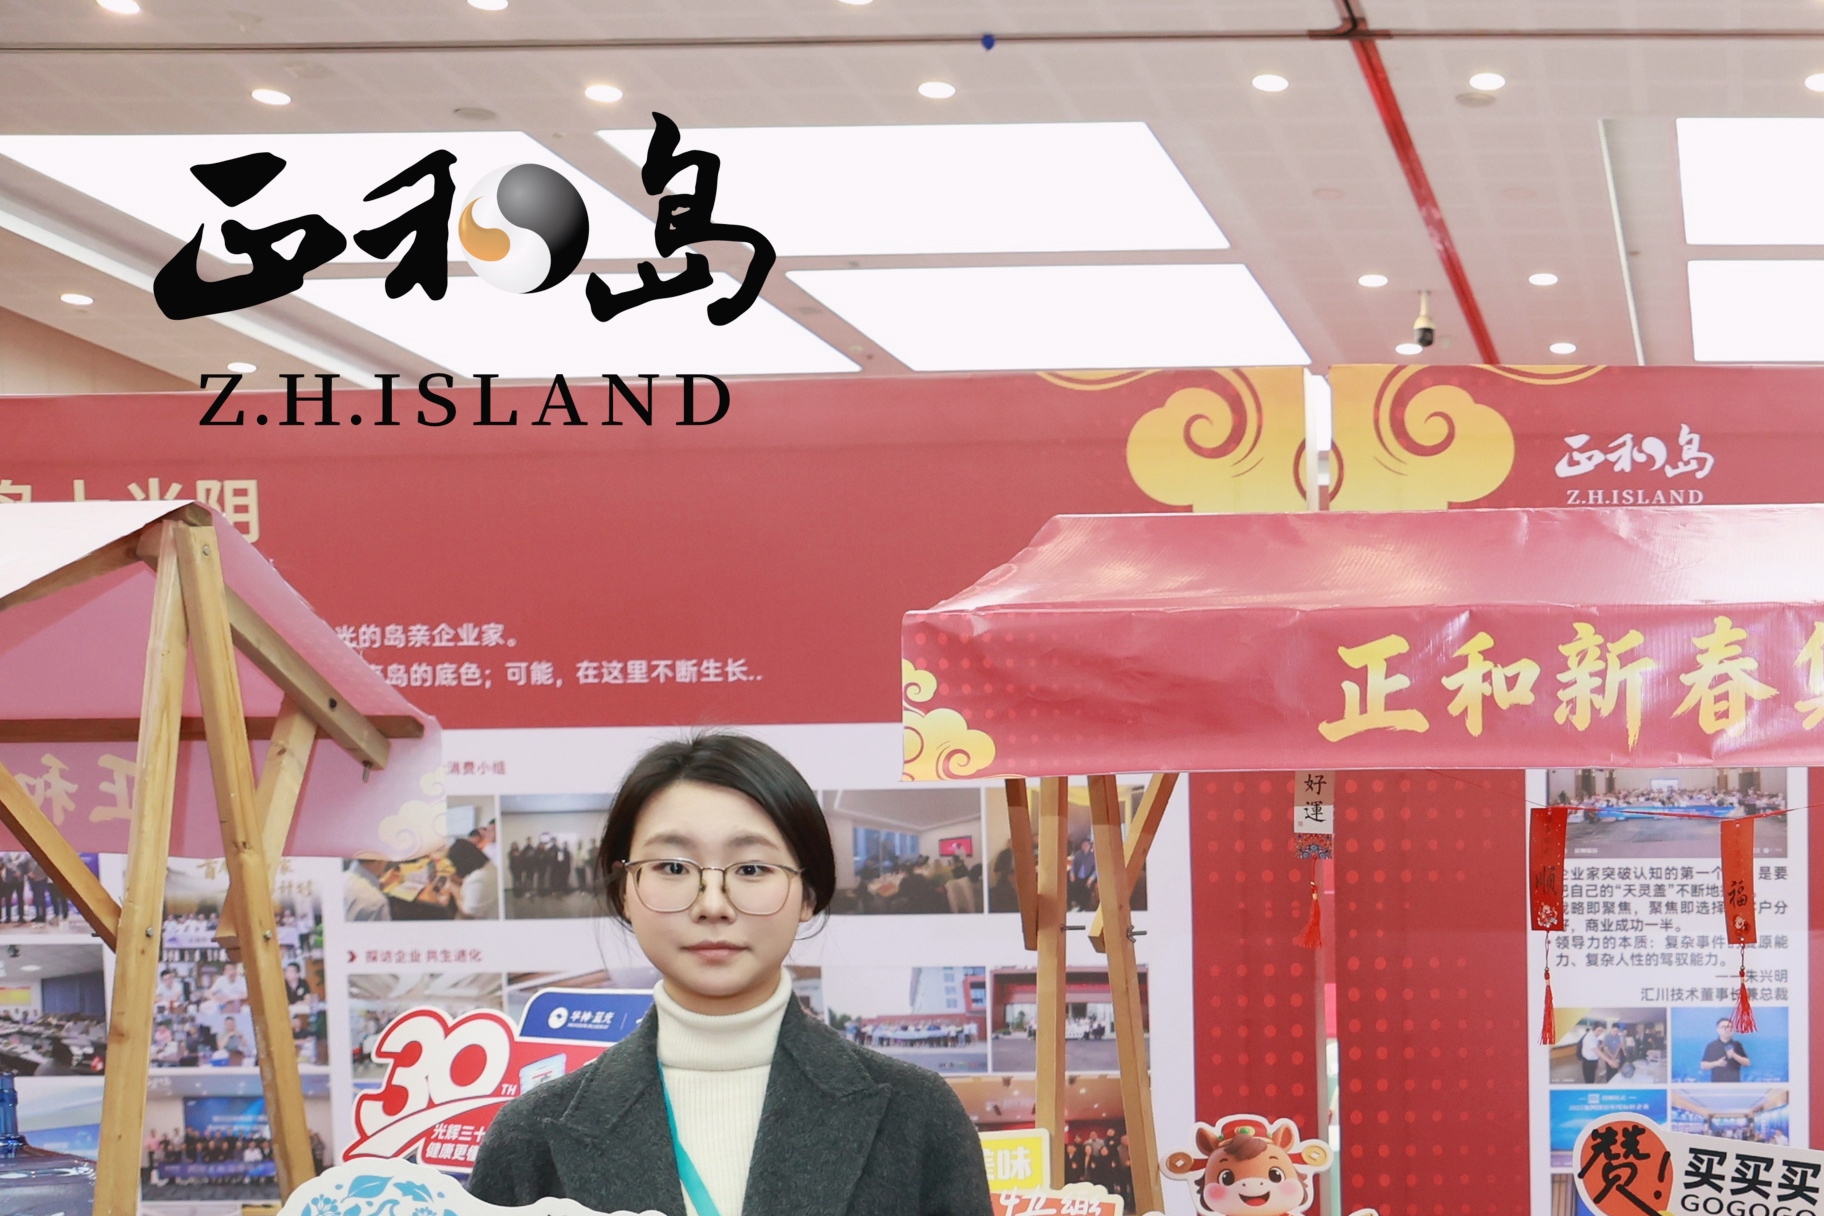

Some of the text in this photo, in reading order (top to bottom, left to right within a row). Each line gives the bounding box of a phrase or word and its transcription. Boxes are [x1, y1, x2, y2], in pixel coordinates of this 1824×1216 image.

[1555, 423, 1715, 480] 正和岛
[1566, 489, 1704, 505] Z.H.ISLAND
[1303, 773, 1328, 823] 好運
[1727, 880, 1749, 906] 福
[1555, 934, 1789, 950] 领导力的本质：复杂事件原能
[1555, 953, 1729, 968] 力、复杂人性的驾驭能力。
[358, 1008, 511, 1120] 30
[500, 1083, 518, 1096] TH
[1680, 1147, 1823, 1206] 买买买
